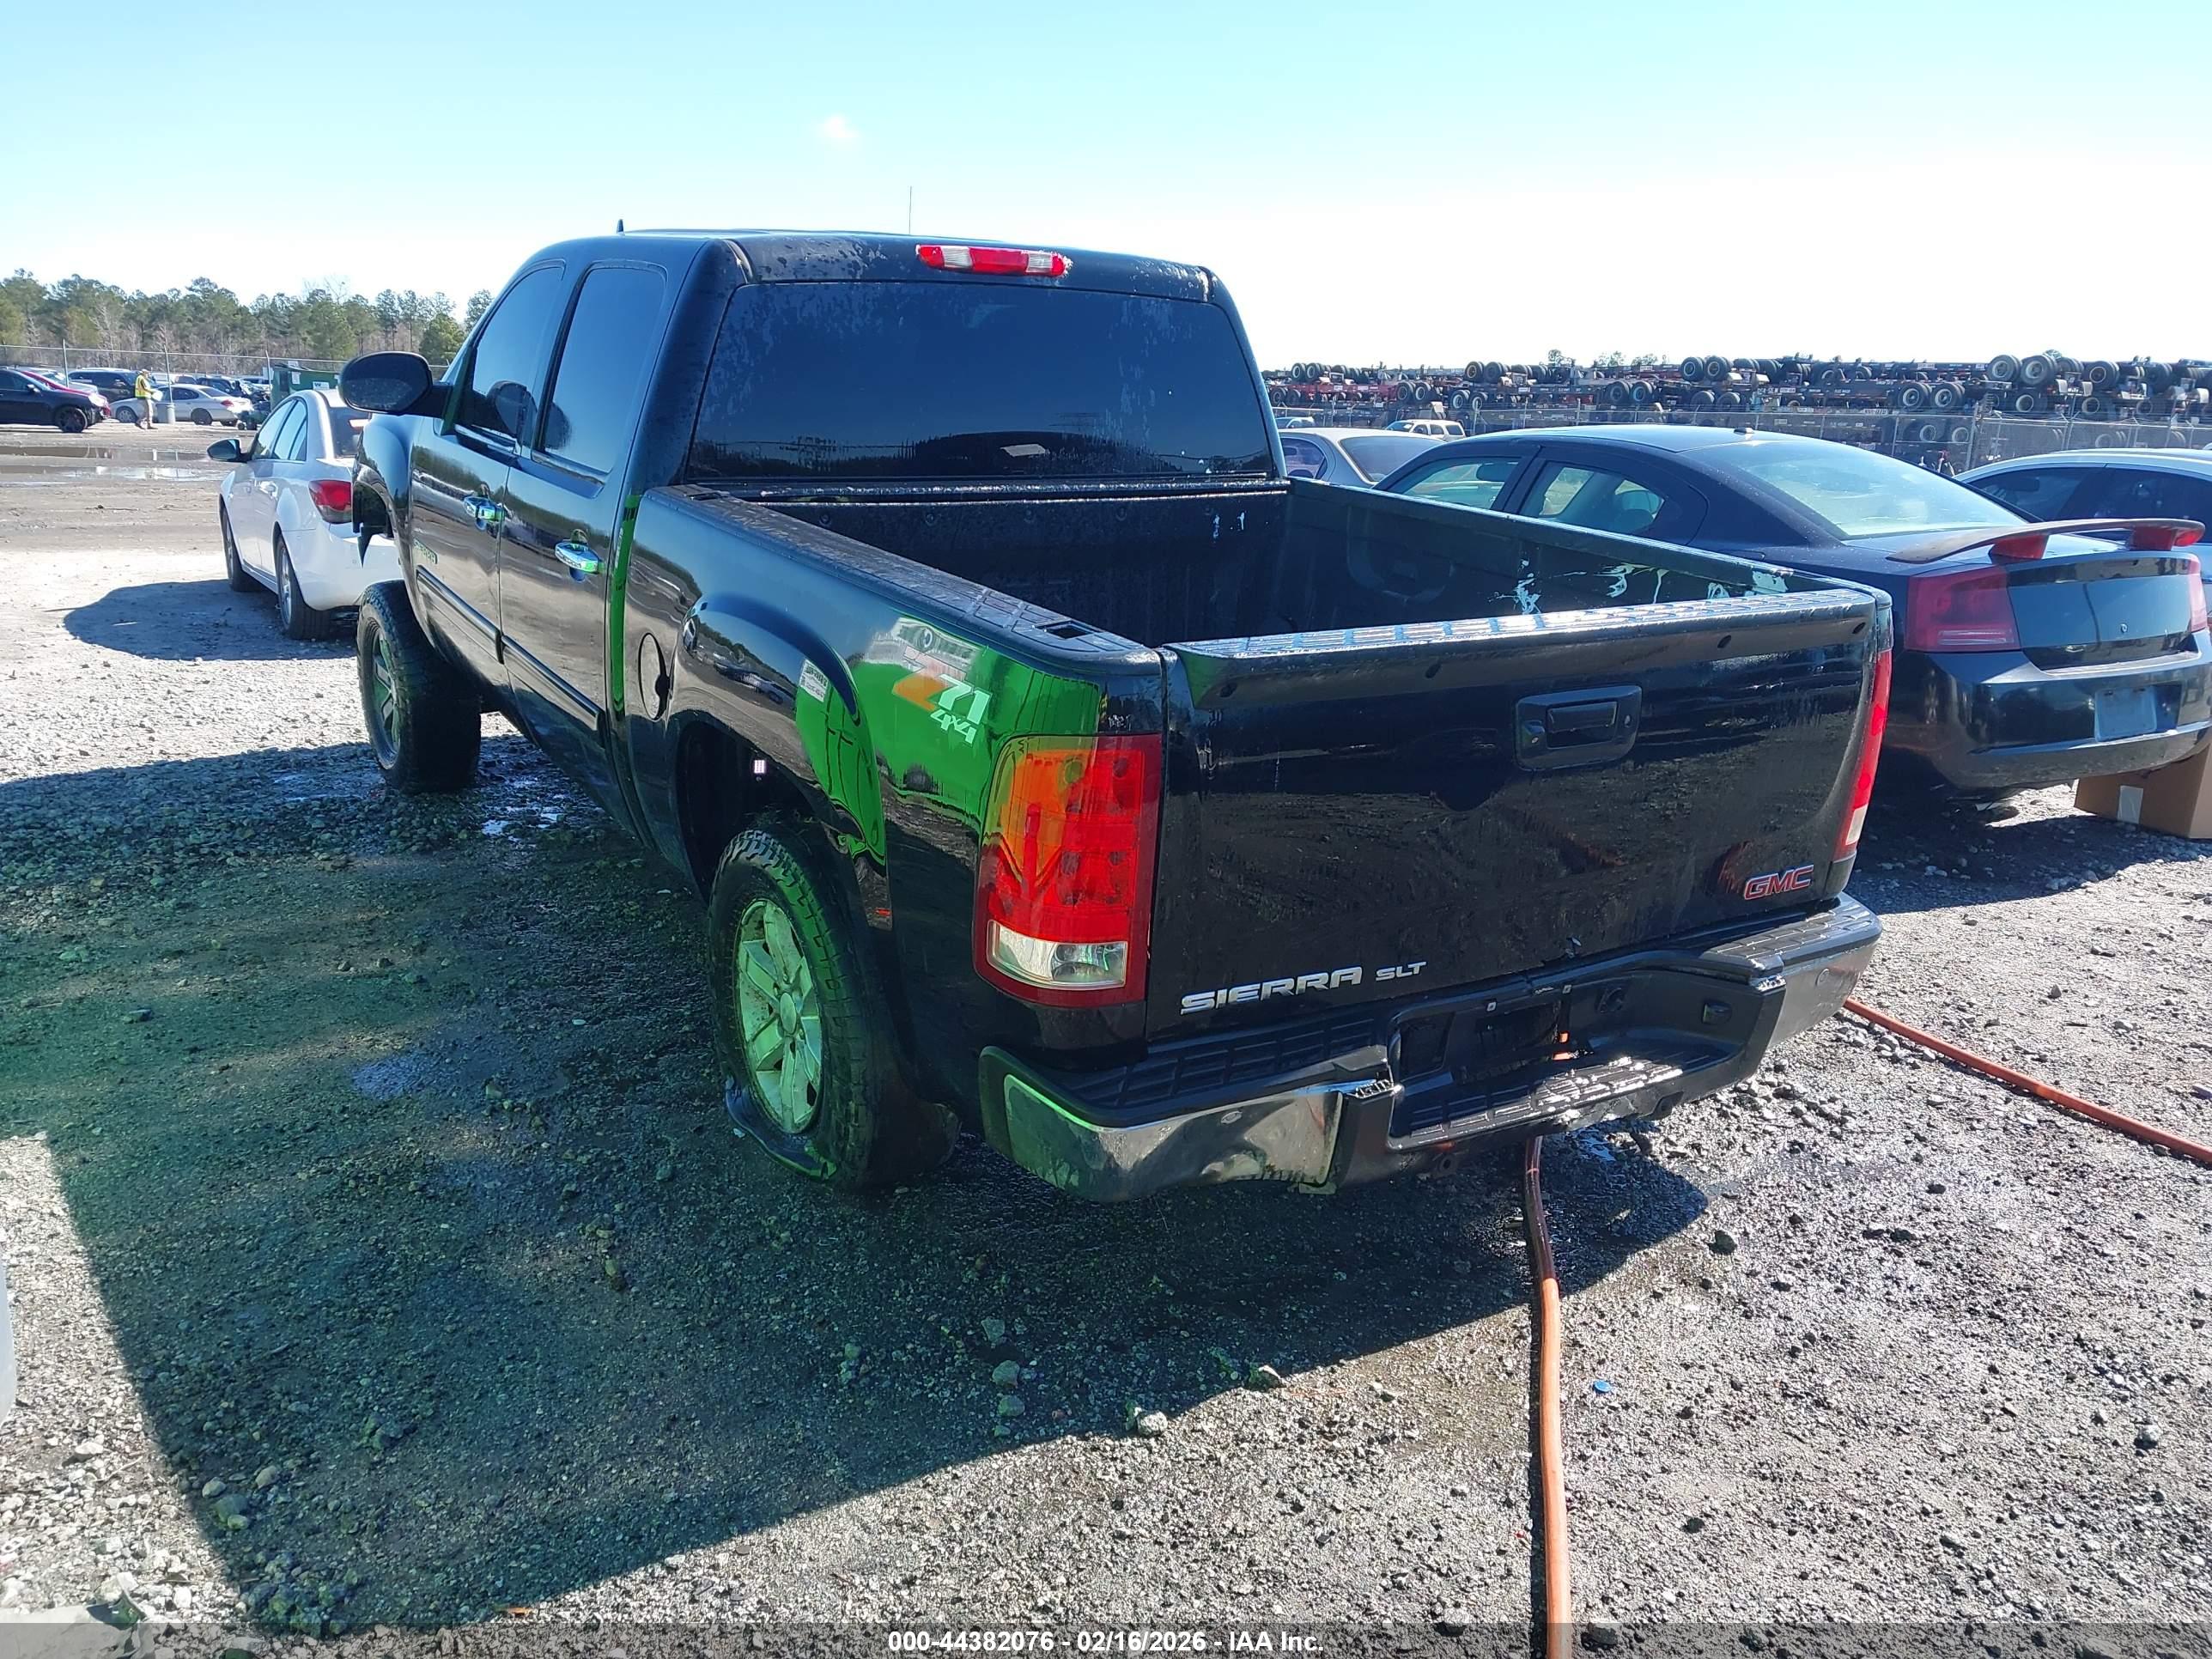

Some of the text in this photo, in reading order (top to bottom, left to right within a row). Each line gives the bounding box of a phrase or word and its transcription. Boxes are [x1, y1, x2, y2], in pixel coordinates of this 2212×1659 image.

[1744, 865, 1814, 901] GMC
[1181, 962, 1427, 1015] SIERRA SLT
